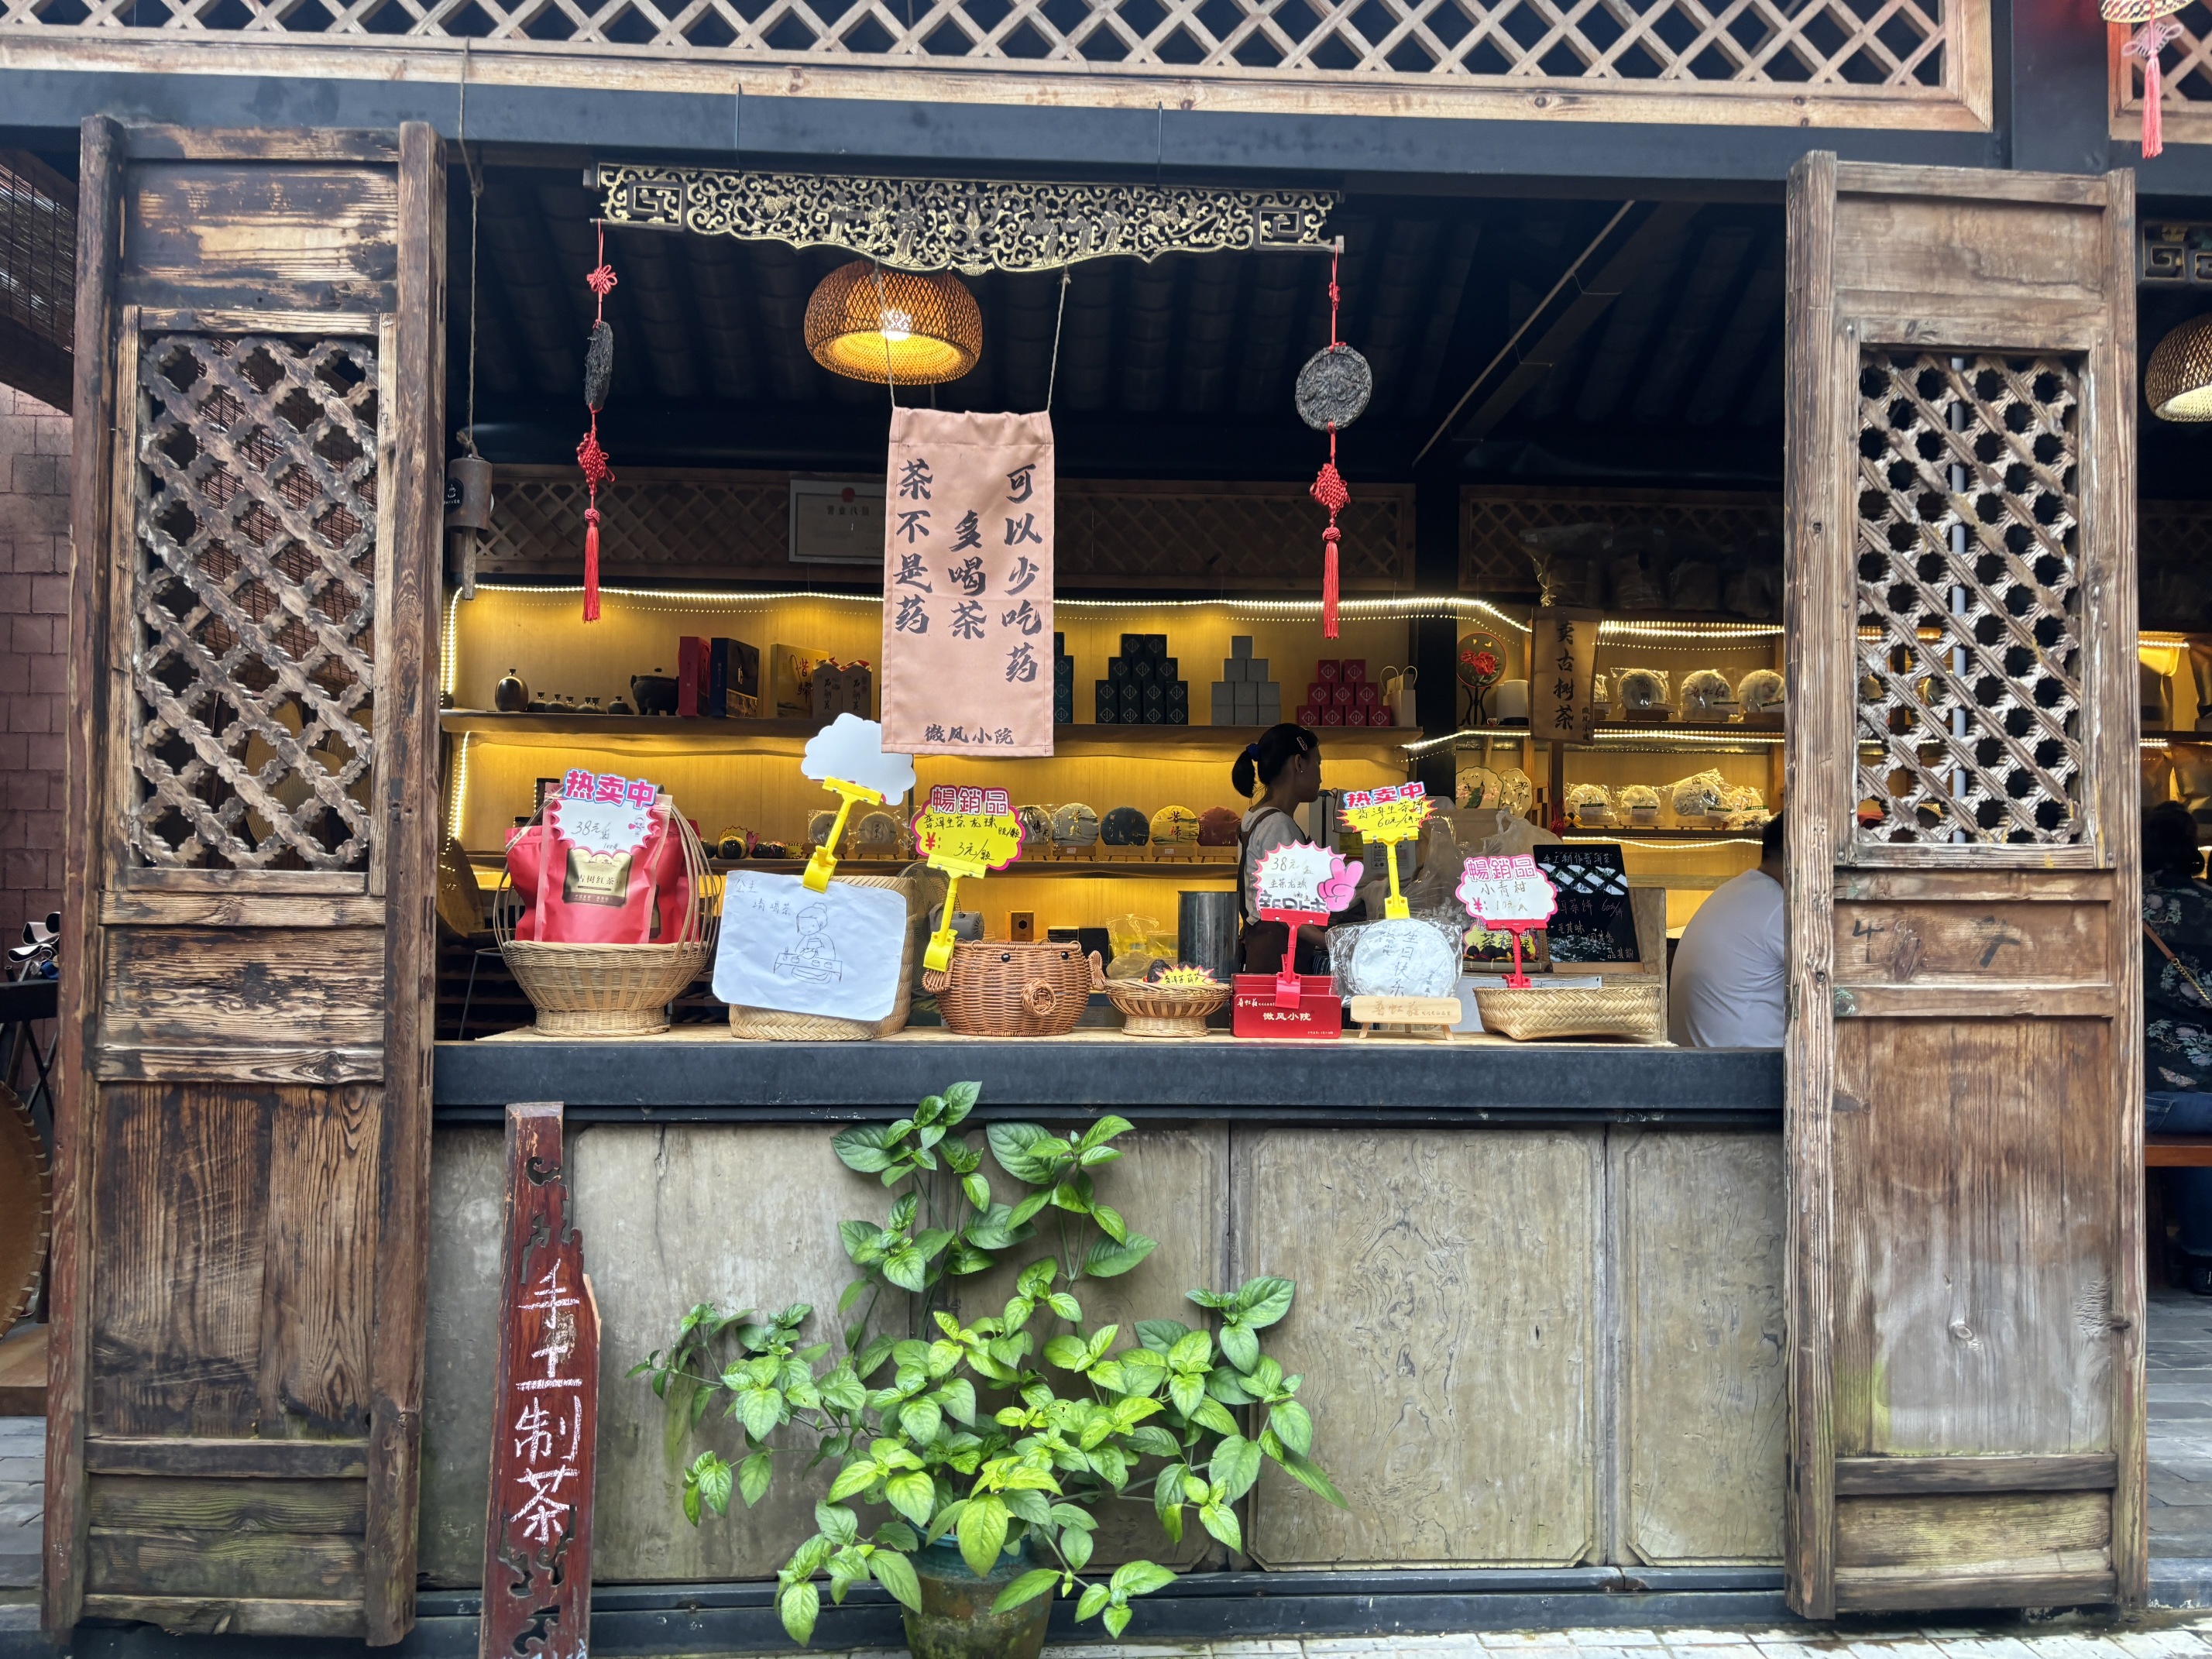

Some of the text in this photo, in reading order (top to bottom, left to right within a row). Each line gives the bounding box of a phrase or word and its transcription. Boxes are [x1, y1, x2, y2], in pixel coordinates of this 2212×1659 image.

[894, 459, 933, 635] 茶不是药
[948, 510, 987, 640] 多喝茶
[1001, 463, 1043, 682] 可以少吃药
[1553, 621, 1575, 730] 卖古树茶
[925, 726, 1015, 745] 微风小院
[565, 770, 654, 808] 热卖中
[933, 788, 1007, 814] 暢銷品
[1346, 783, 1422, 807] 热卖中
[1468, 859, 1535, 880] 暢銷品
[736, 879, 757, 893] 公主
[753, 898, 790, 915] 请喝茶
[1263, 1012, 1311, 1021] 微风小院
[510, 1258, 583, 1544] 手工制茶
